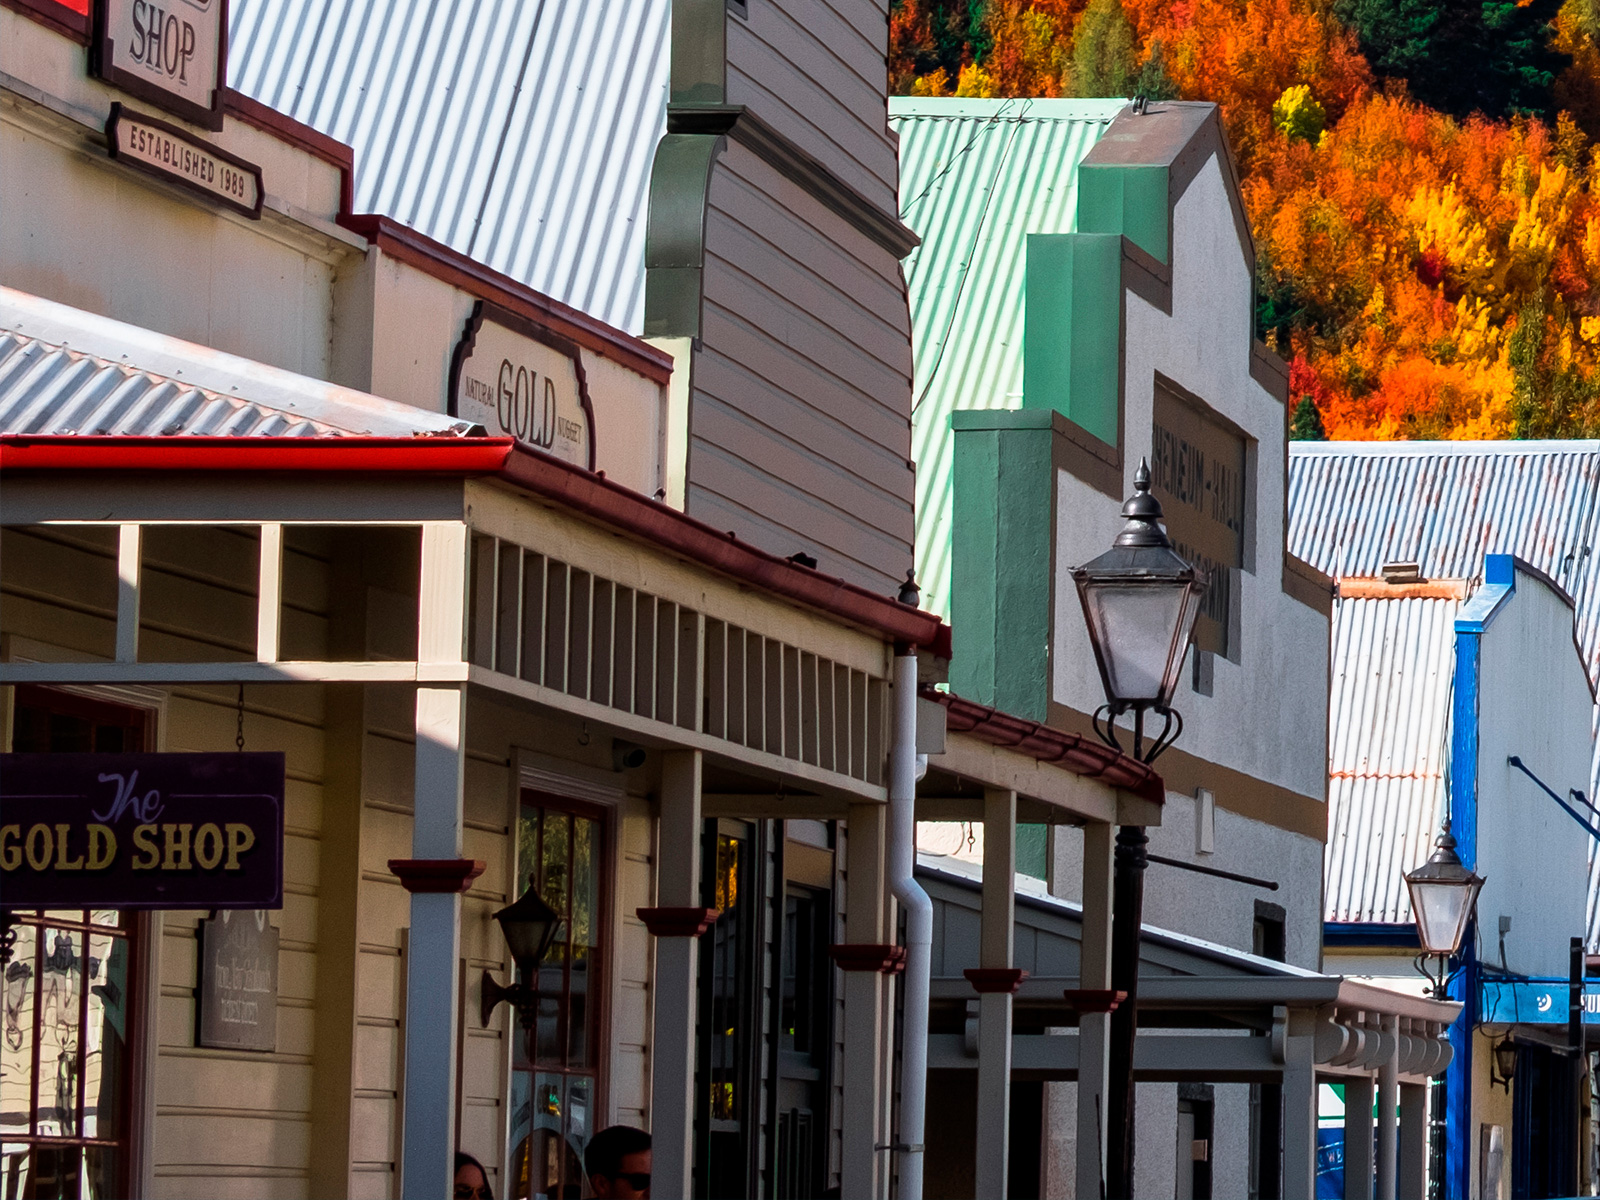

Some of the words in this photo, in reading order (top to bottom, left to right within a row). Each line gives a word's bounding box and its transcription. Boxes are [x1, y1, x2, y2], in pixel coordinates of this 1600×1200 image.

[129, 0, 195, 82] SHOP
[130, 125, 214, 183] ESTABLISHED
[219, 166, 245, 198] 1989
[465, 375, 495, 408] NATURAL
[497, 358, 556, 450] GOLD
[557, 416, 582, 444] NUGGET
[91, 769, 165, 824] The
[0, 823, 118, 872] GOLD
[132, 823, 256, 871] SHOP
